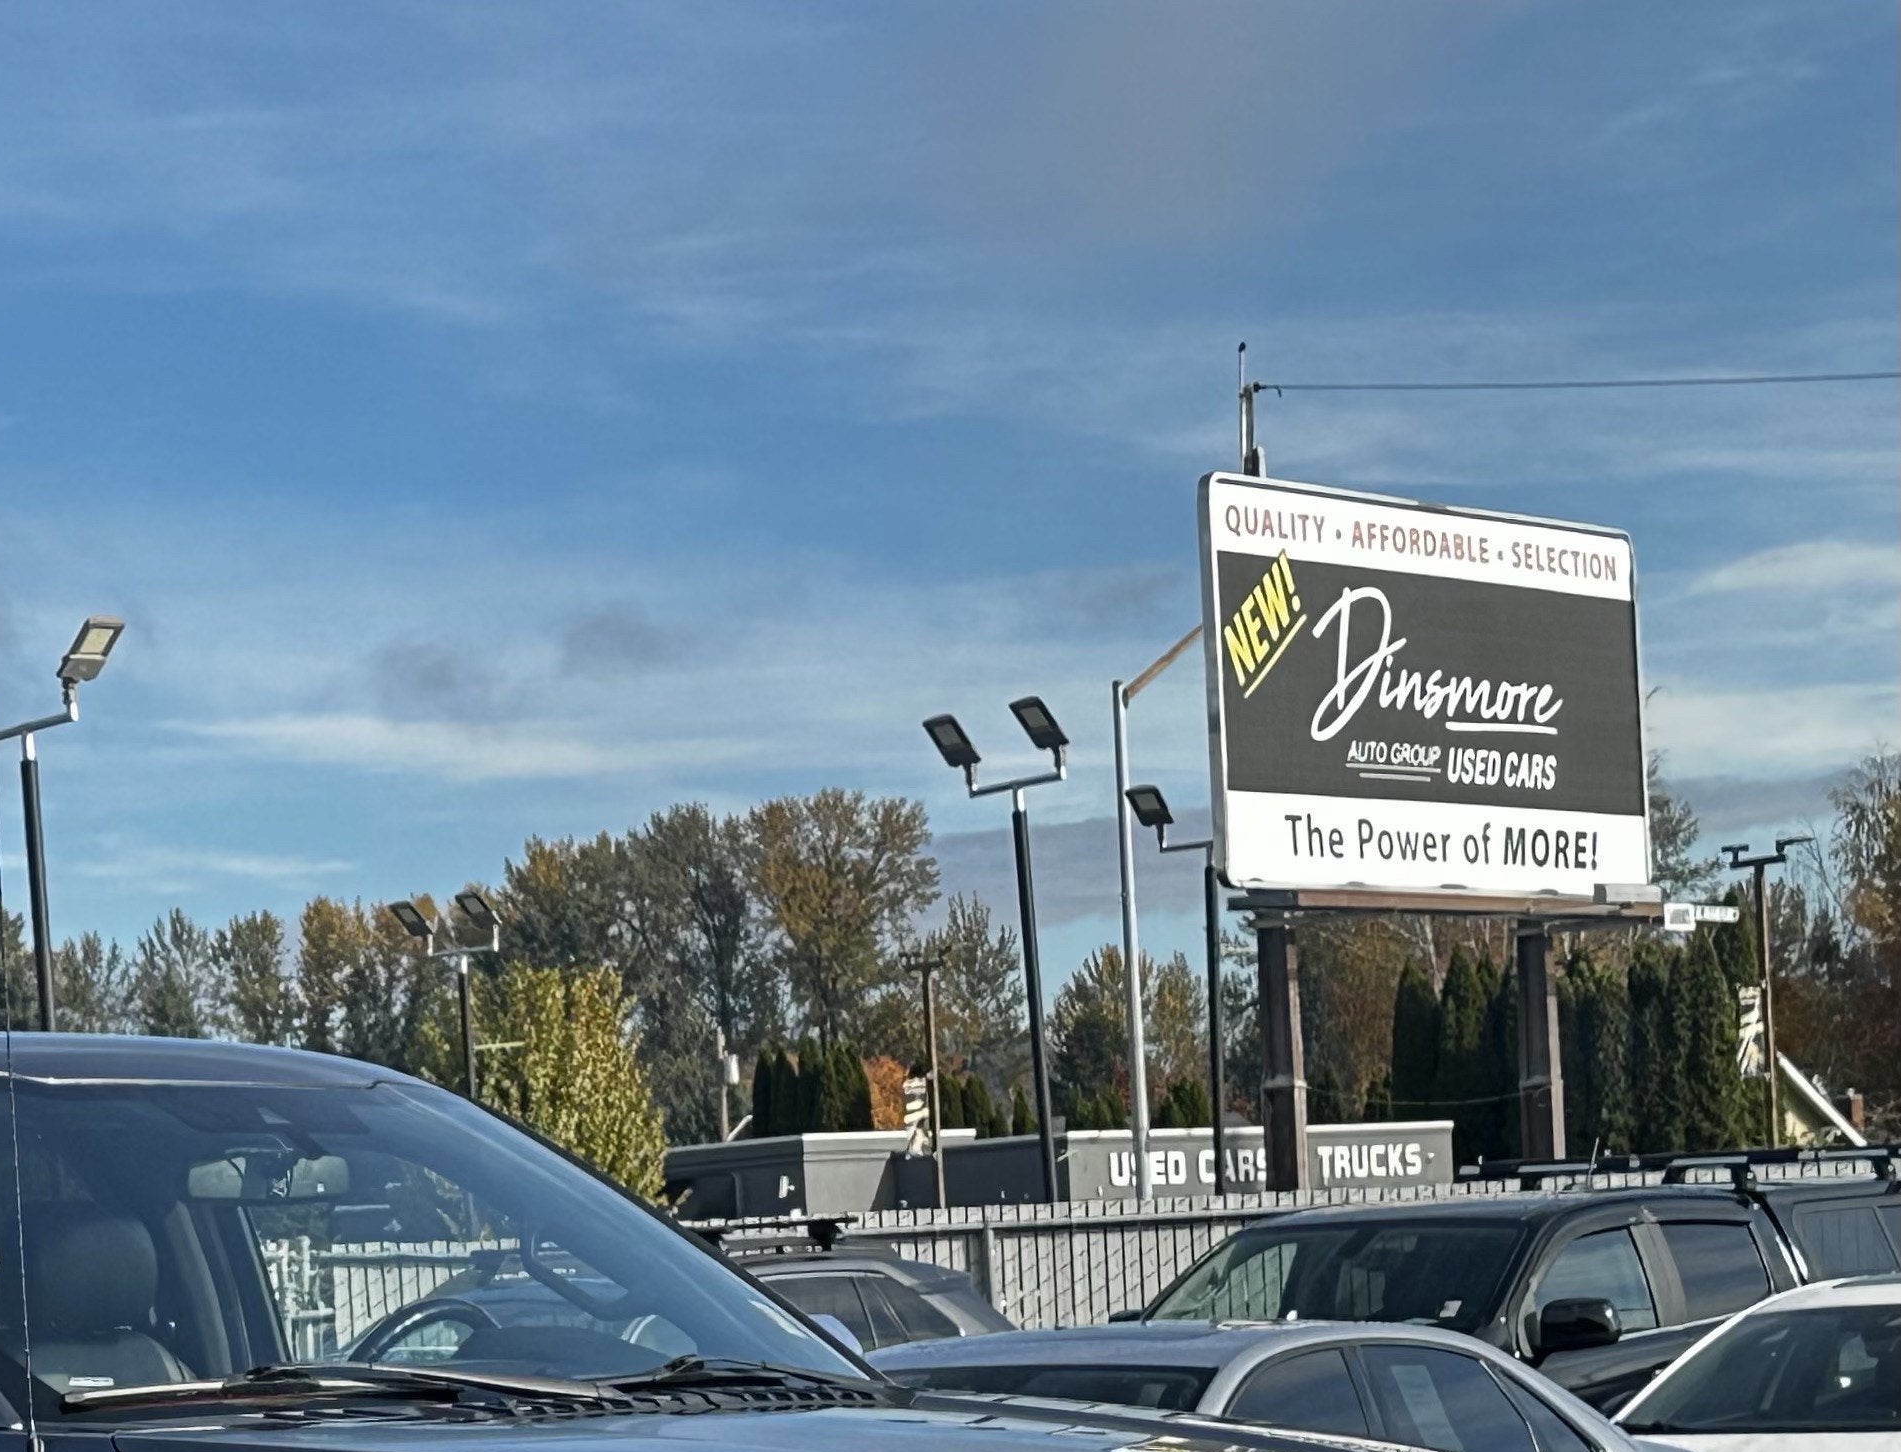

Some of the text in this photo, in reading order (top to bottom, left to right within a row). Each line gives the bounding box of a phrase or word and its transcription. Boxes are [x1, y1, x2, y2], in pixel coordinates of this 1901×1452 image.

[1225, 504, 1617, 582] QUALITY AFFORDABLE SELECTION
[1223, 549, 1301, 688] NEW!
[1310, 586, 1563, 742] Dinsmore
[1347, 739, 1558, 790] AUTO GROUP USED CARS
[1284, 813, 1598, 871] The Power of MORE!
[1317, 1143, 1423, 1186] TRUCKS
